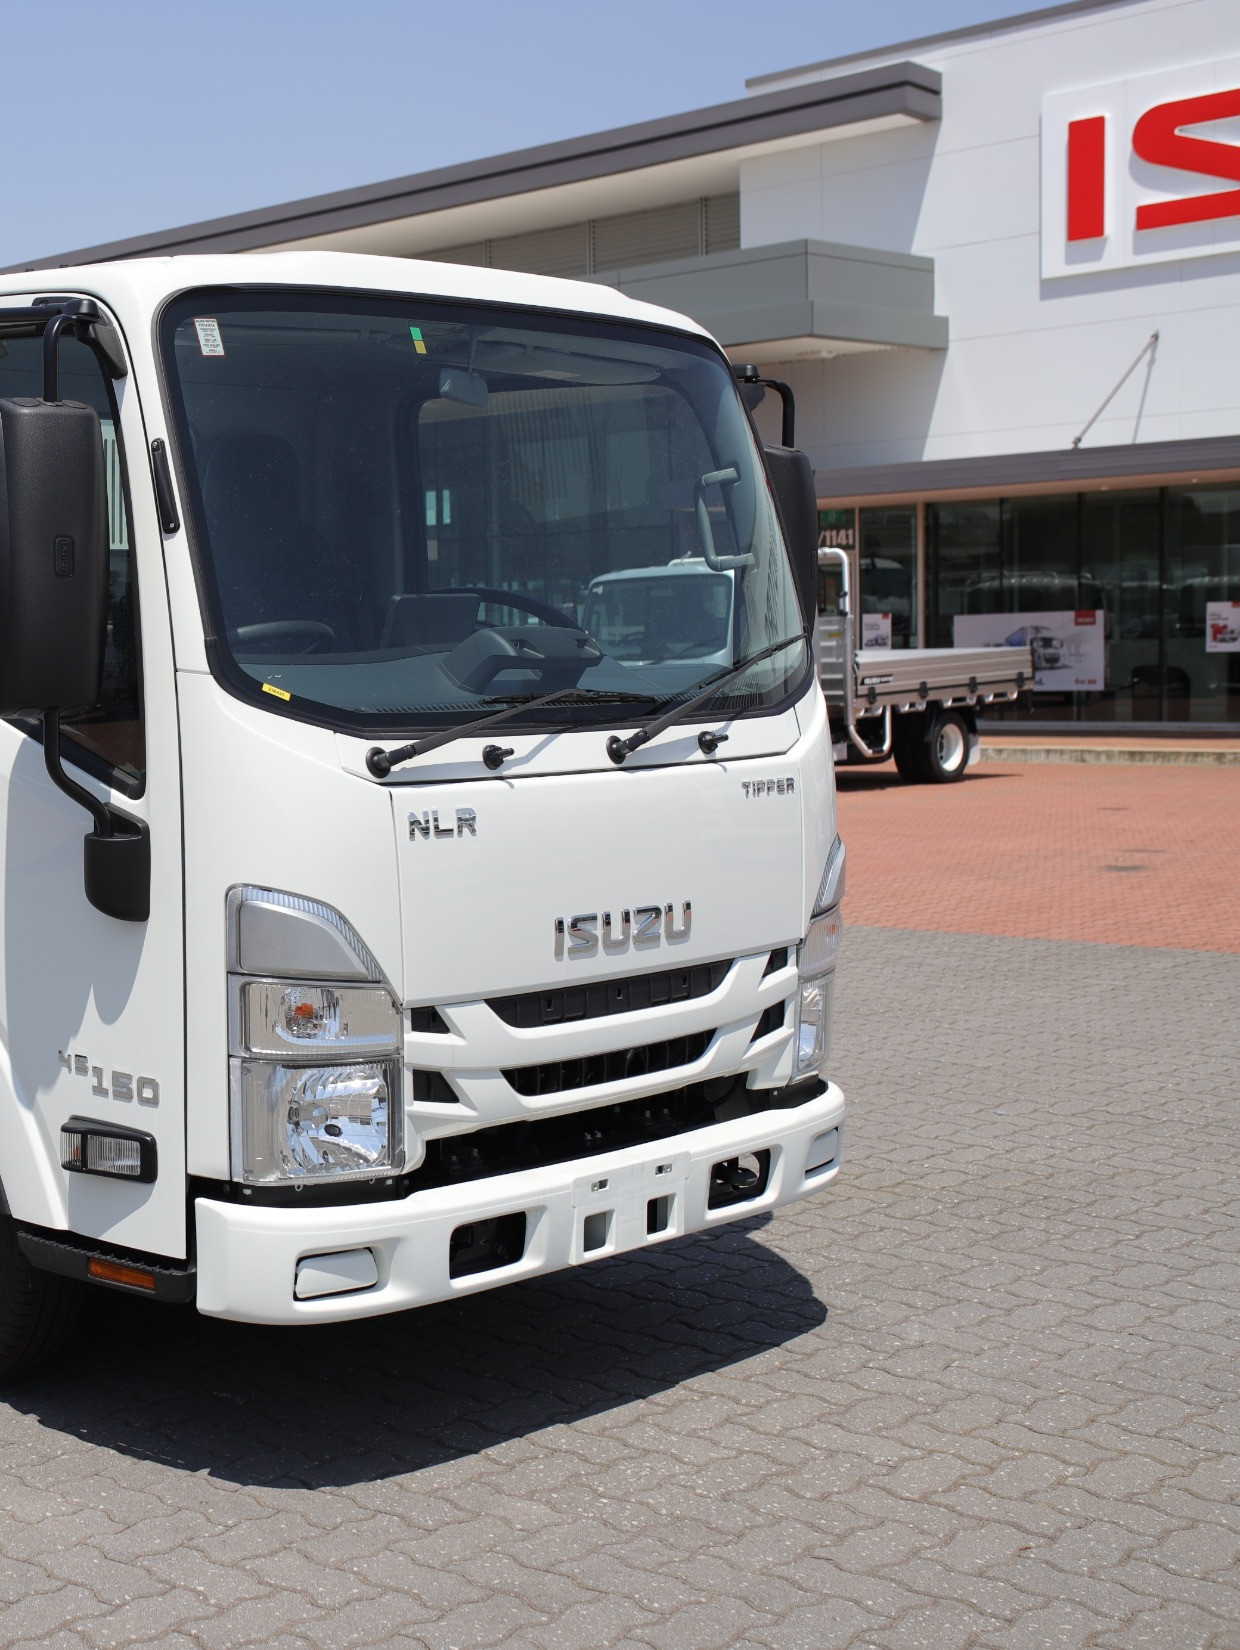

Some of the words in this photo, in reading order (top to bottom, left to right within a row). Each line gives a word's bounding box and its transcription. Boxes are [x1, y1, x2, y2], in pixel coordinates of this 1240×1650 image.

[741, 776, 795, 799] TIPPER
[406, 806, 478, 842] NLR
[553, 899, 692, 962] ISUZU
[91, 1065, 159, 1106] 150
